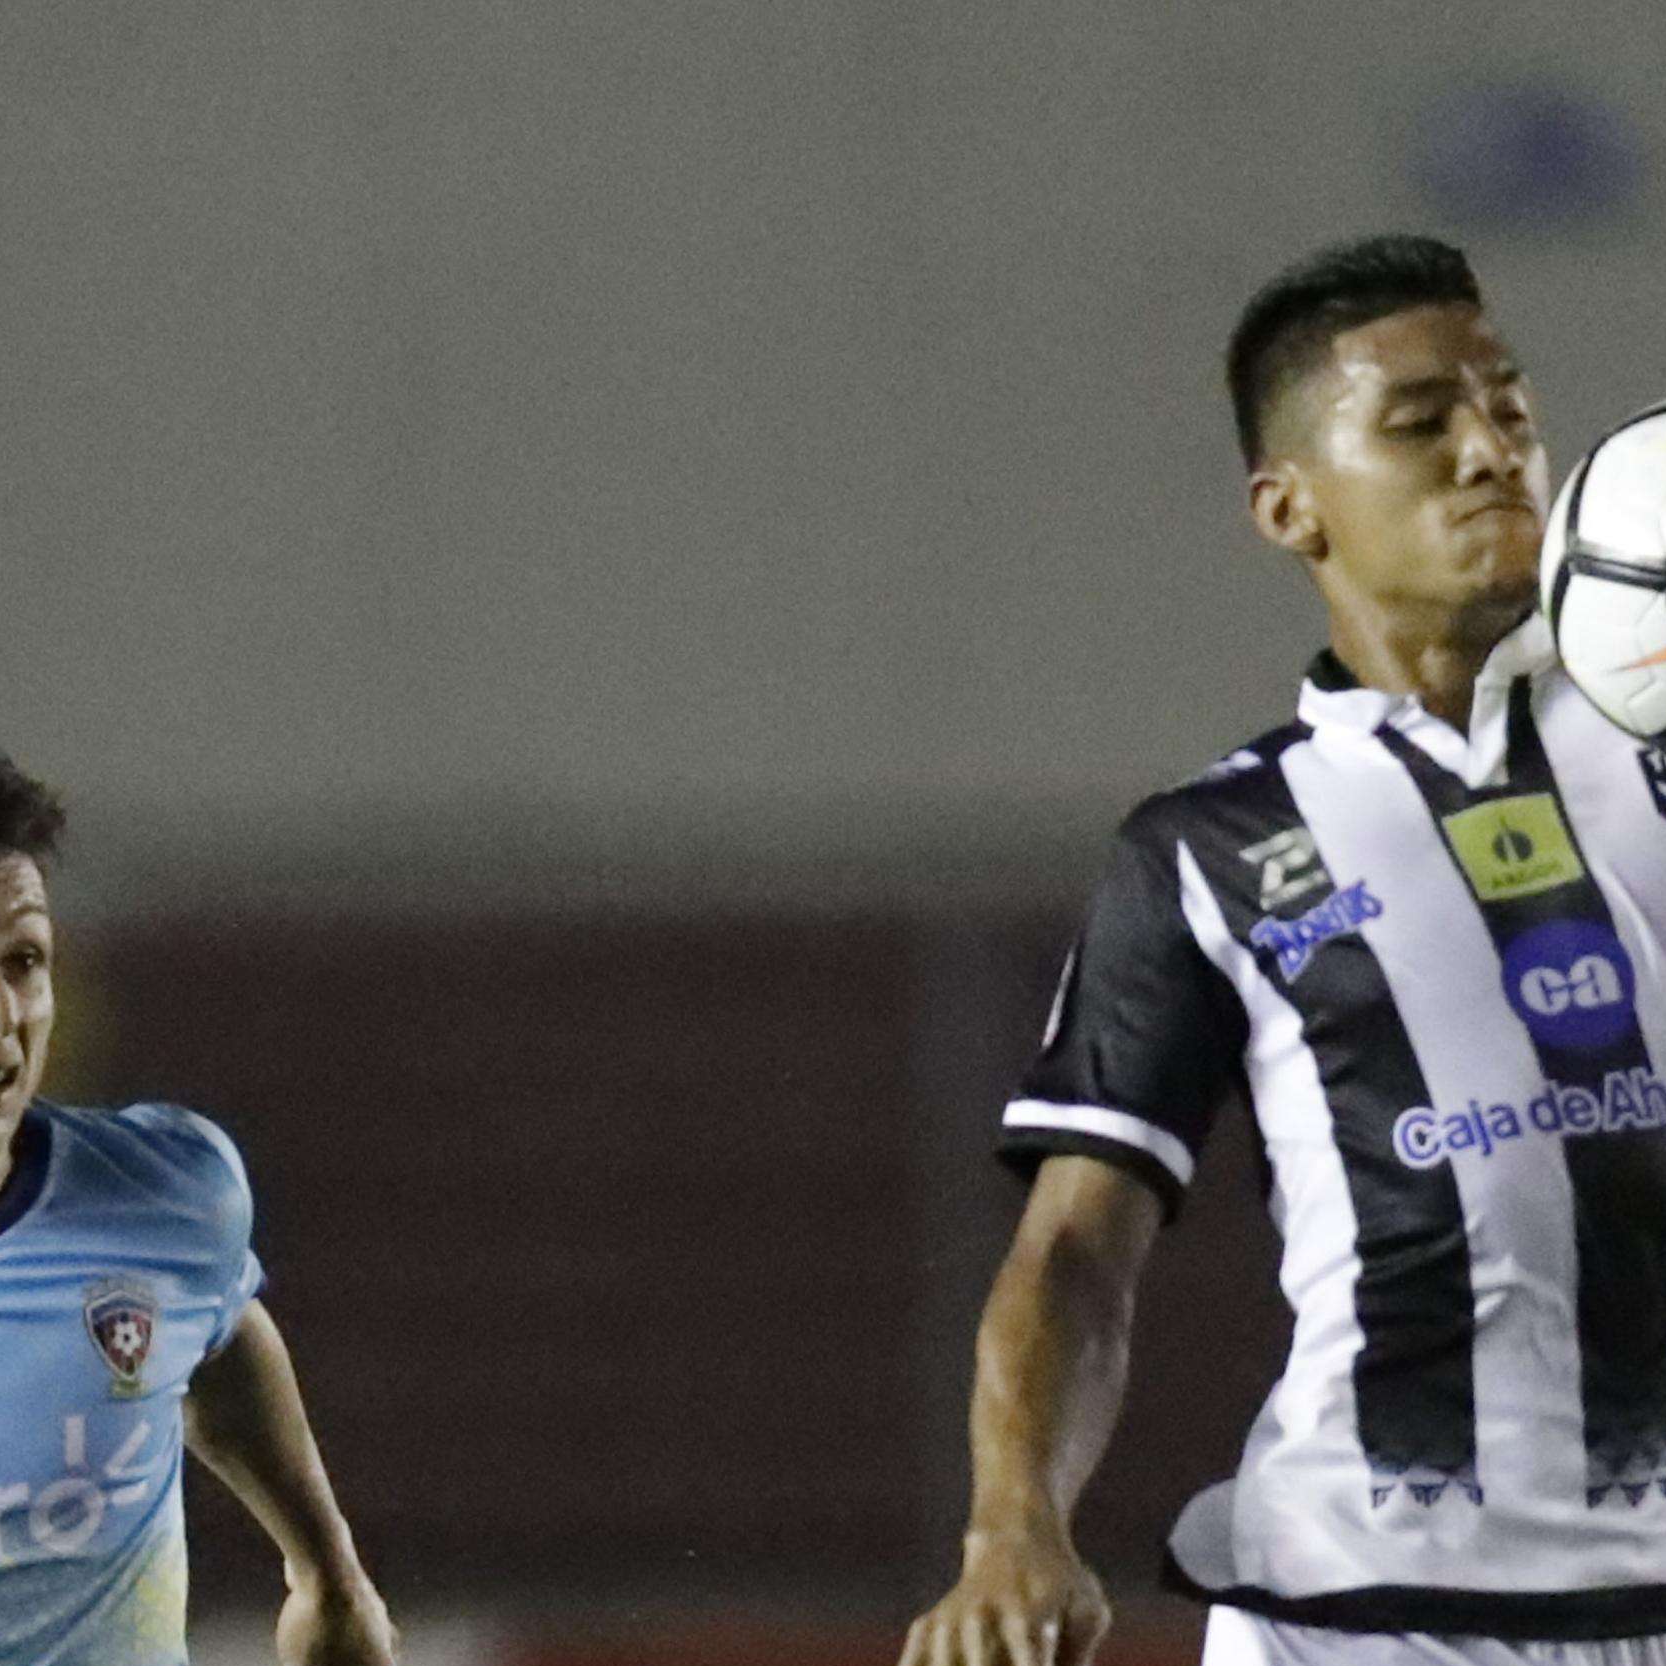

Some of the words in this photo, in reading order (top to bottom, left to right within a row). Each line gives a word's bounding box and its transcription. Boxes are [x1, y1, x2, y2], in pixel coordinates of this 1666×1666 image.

[1519, 954, 1623, 1016] ca
[1395, 1098, 1523, 1166] Caja
[1527, 1082, 1600, 1134] de
